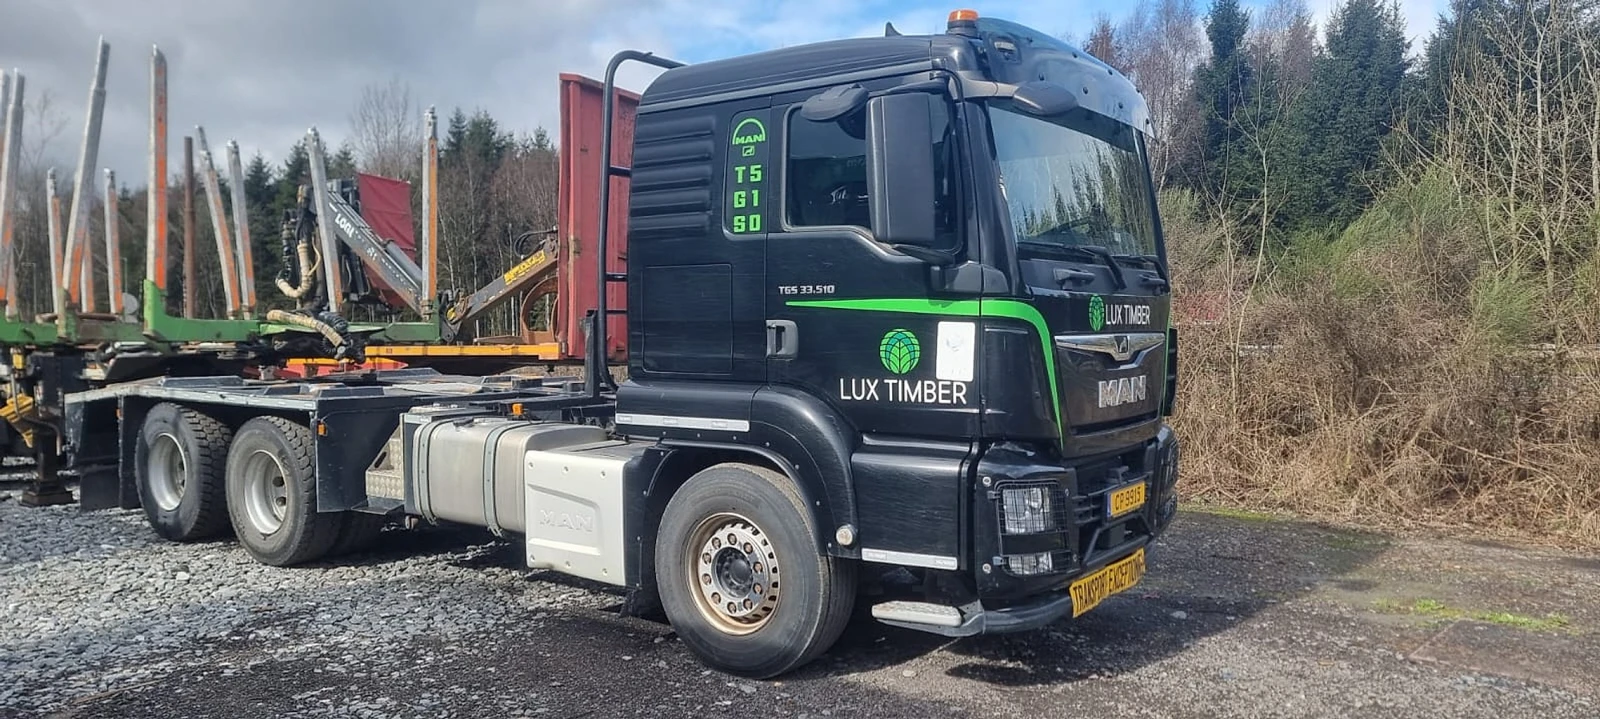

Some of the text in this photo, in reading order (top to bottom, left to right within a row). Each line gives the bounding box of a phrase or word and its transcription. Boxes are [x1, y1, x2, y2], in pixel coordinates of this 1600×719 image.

[736, 134, 763, 145] MAN
[778, 285, 835, 294] TGS 33.510
[1105, 304, 1151, 325] LUX TIMBER
[839, 378, 967, 405] LUX TIMBER
[1098, 375, 1147, 408] MAN
[539, 509, 593, 532] MAN
[1072, 570, 1108, 614] TRANSPORT
